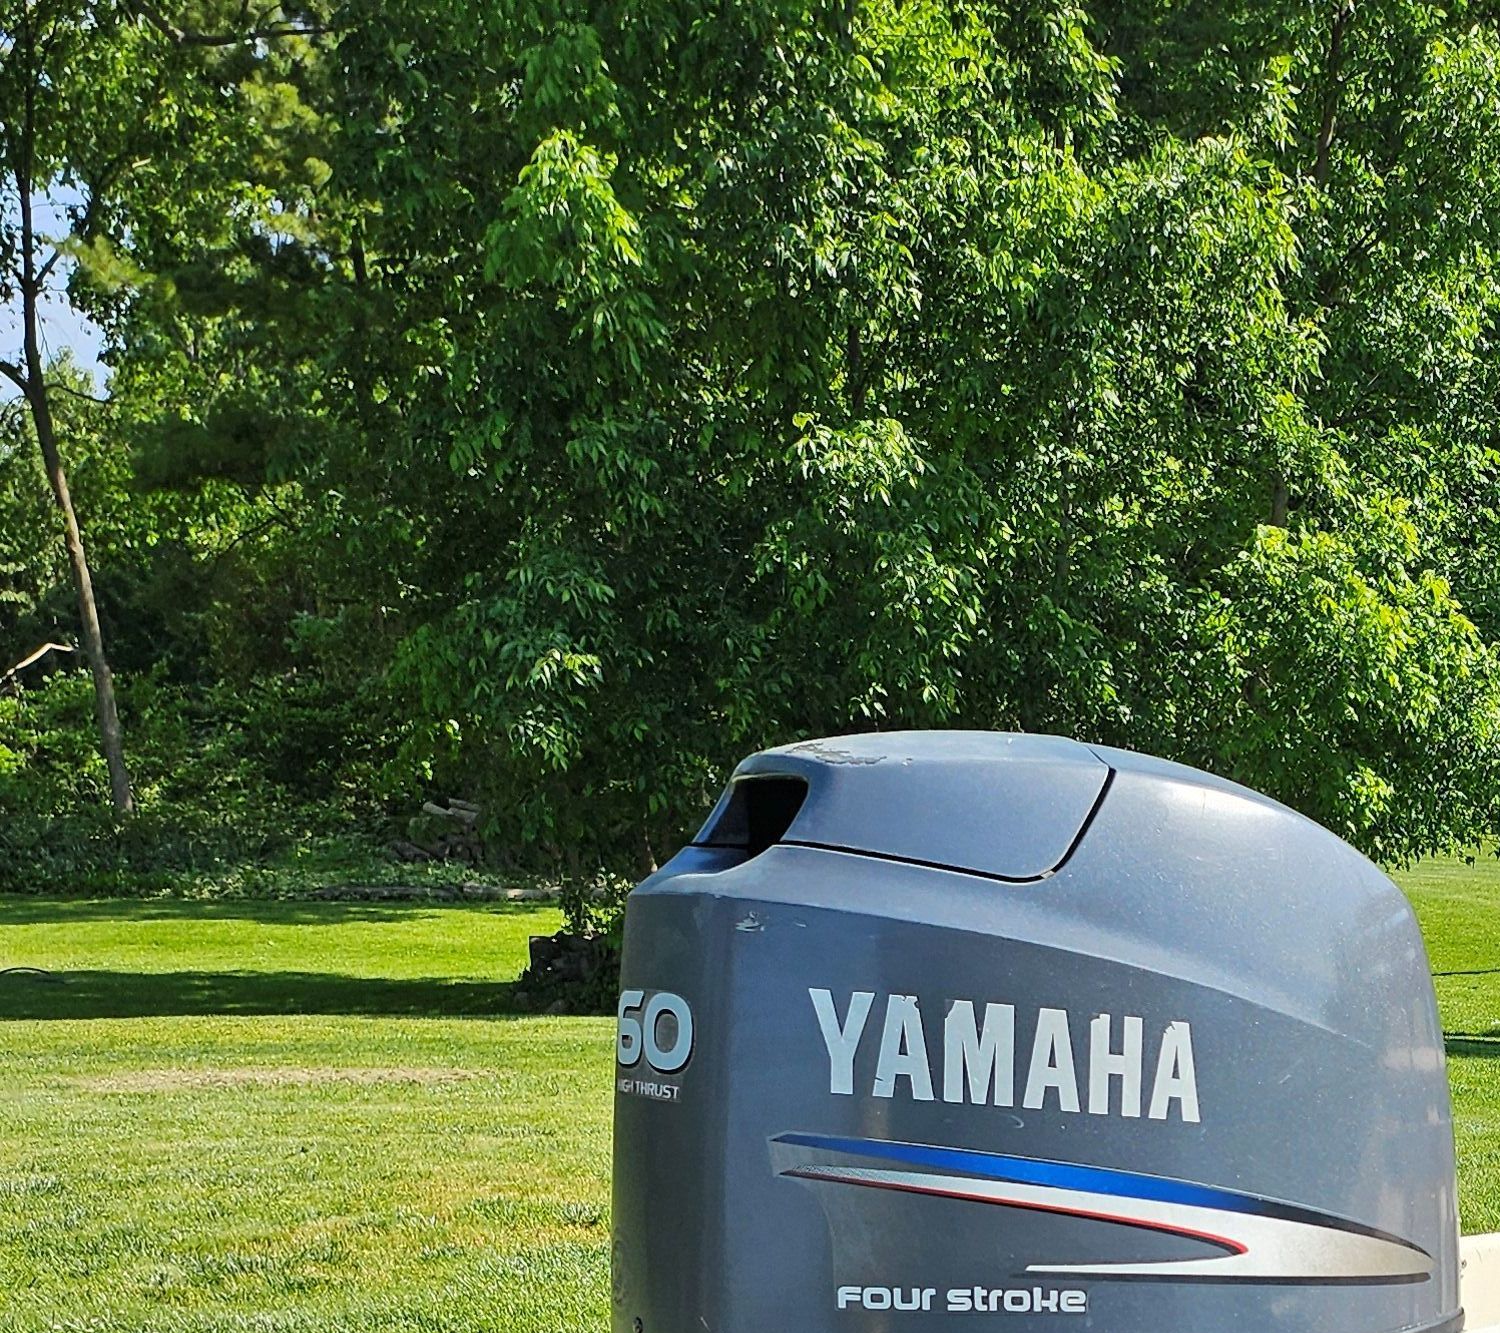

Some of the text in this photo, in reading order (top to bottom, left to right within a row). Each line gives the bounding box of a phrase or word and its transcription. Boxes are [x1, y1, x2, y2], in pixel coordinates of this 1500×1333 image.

[617, 990, 694, 1074] 60
[809, 988, 1201, 1123] YAMAHA
[635, 1081, 680, 1100] THRUST
